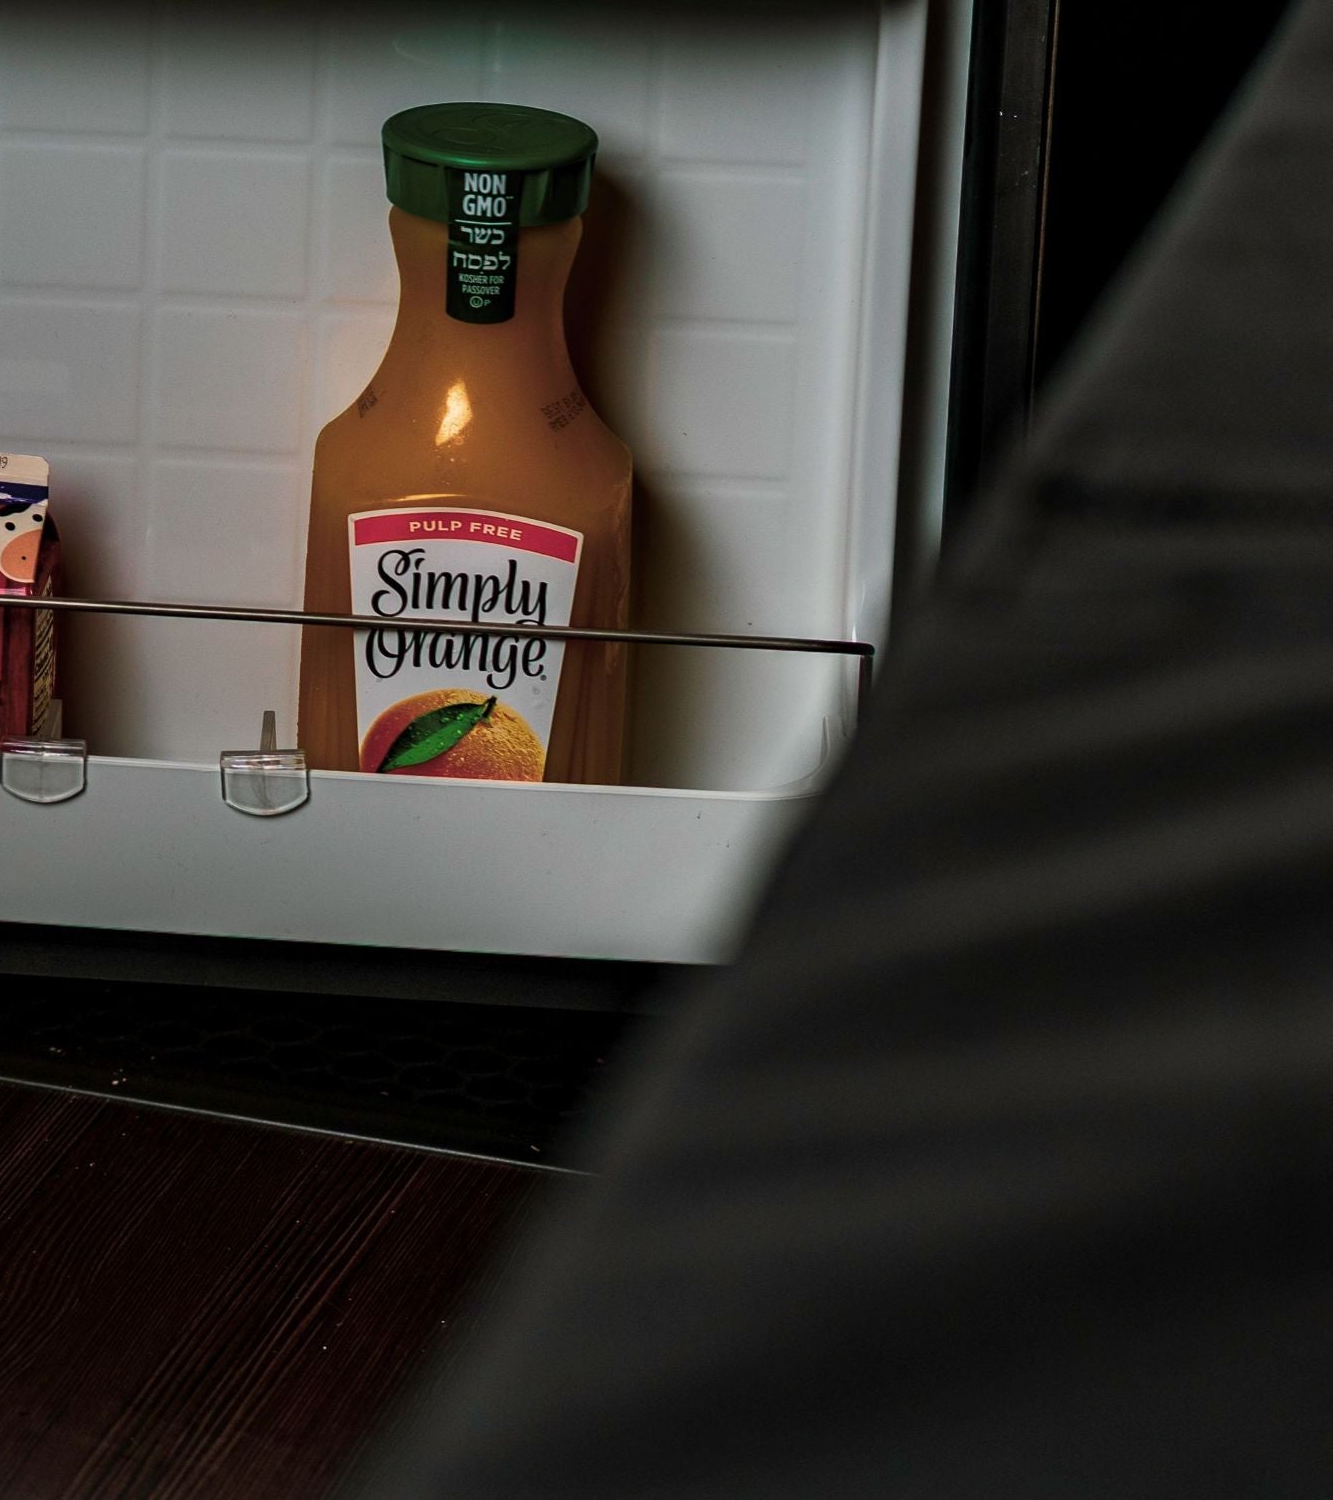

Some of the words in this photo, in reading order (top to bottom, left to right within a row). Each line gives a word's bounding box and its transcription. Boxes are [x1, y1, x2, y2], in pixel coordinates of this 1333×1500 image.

[464, 172, 507, 195] NON
[462, 194, 508, 218] GMO
[460, 225, 505, 245] כשר
[452, 250, 511, 271] לפסח
[458, 273, 488, 284] KOSHER
[489, 275, 505, 284] FOR
[462, 284, 501, 295] PASSOVER
[408, 519, 463, 533] PULP
[469, 521, 523, 542] FREE
[371, 548, 549, 626] Simply
[365, 627, 548, 690] Orange
